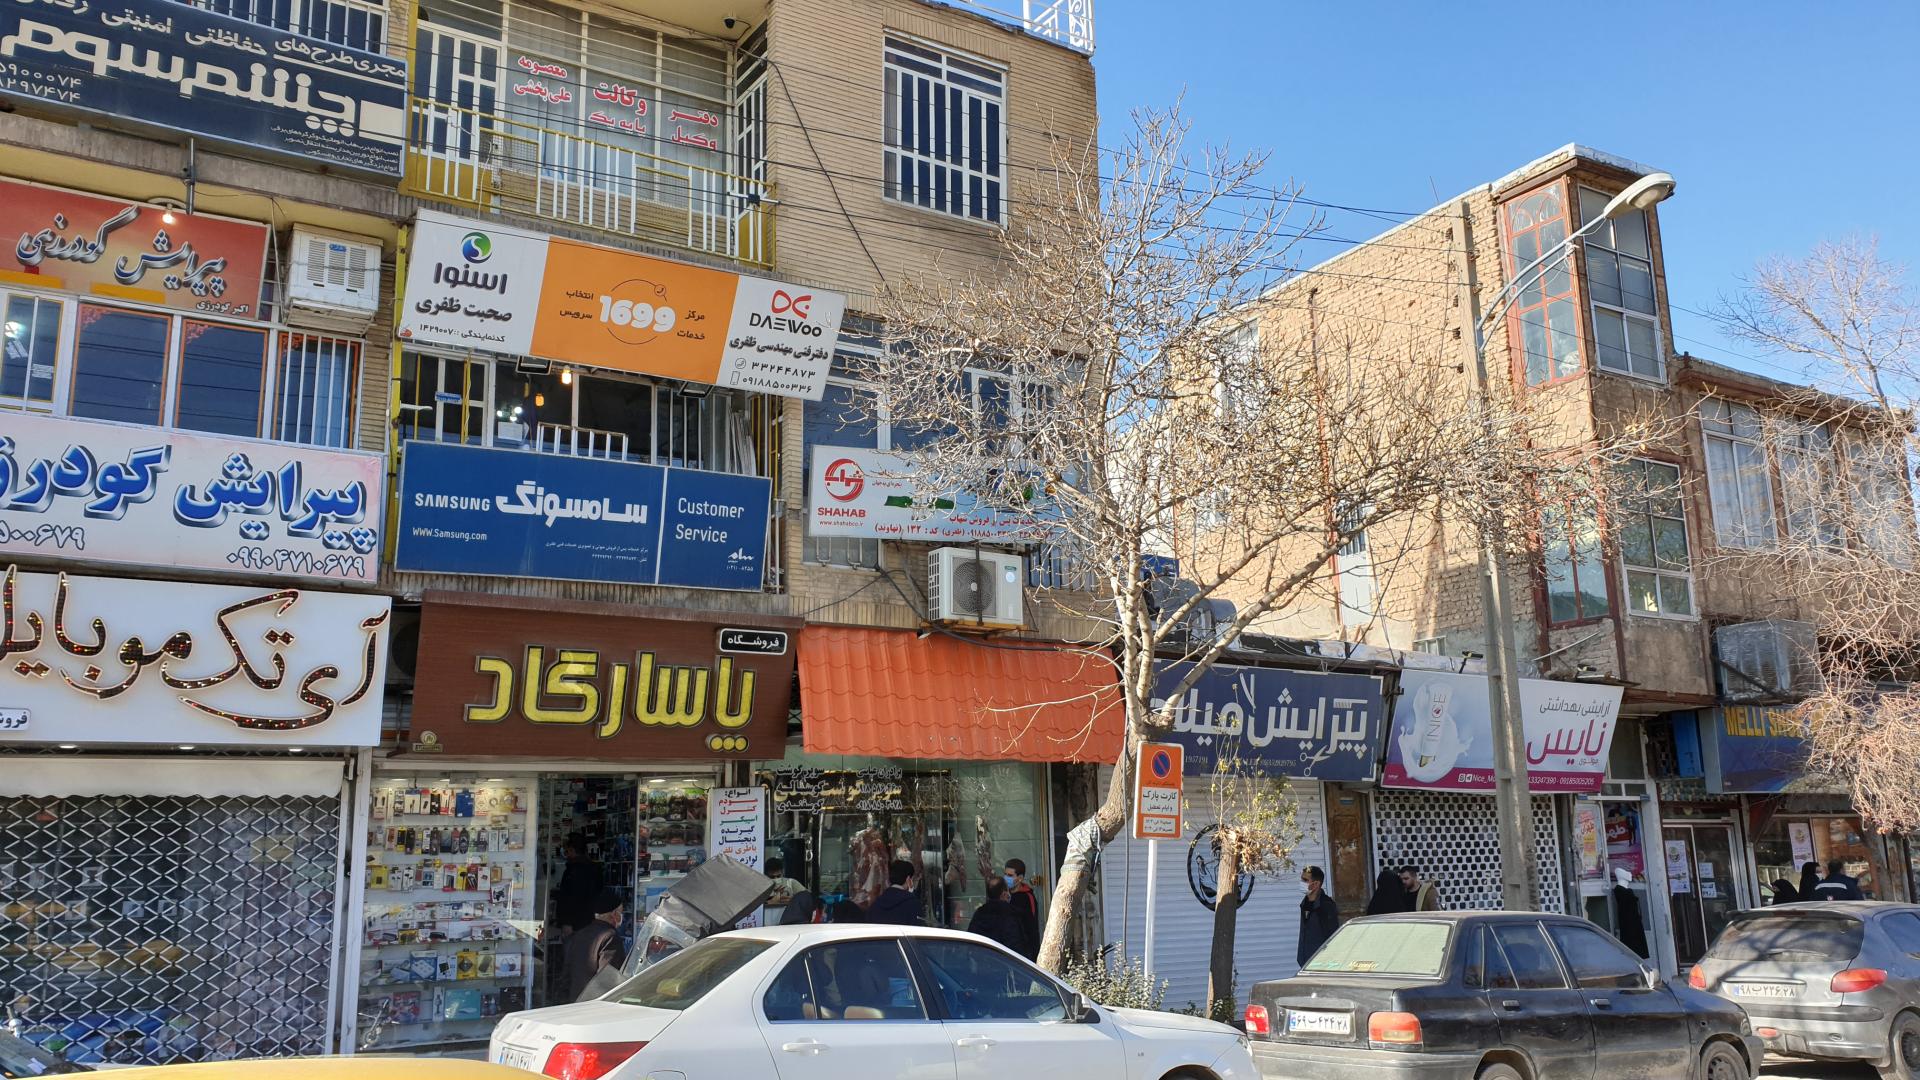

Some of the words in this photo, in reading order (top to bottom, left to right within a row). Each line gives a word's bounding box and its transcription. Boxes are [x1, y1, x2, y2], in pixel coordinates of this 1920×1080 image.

[101, 8, 171, 34] امنیتی
[1, 18, 184, 83] سوم
[185, 27, 267, 55] حفاظتی
[354, 60, 406, 78] مجری
[518, 55, 567, 79] معصومه
[179, 61, 355, 137] چشم
[593, 82, 648, 116] وکالت
[589, 110, 616, 128] یک
[669, 106, 719, 127] دفتر
[671, 125, 718, 151] وکیل
[15, 203, 141, 266] گودرزی
[113, 228, 228, 297] پیرایش
[433, 262, 508, 295] اسنوا
[566, 289, 594, 301] انتخاب
[196, 300, 231, 313] گودرزی
[231, 303, 250, 315] اکبر
[415, 297, 462, 316] ظفری
[463, 304, 513, 323] صحبت
[559, 309, 593, 320] سرویس
[600, 295, 676, 333] 1699
[685, 310, 706, 321] مرکز
[676, 328, 706, 341] خدمات
[749, 312, 823, 338] DAEWOO
[729, 335, 757, 350] ظفری
[756, 343, 793, 356] مهندسی
[793, 345, 812, 359] فنی
[808, 347, 829, 361] دفتر
[751, 361, 816, 378] ۳۳۲۴۴۸۷۳
[742, 377, 812, 393] ۰۹۱۸۸۵۰۰۳۳۶
[173, 452, 377, 554] پیرایش
[415, 492, 491, 511] SAMSUNG
[495, 479, 648, 528] سامسونگ
[678, 497, 745, 519] Customer
[817, 507, 866, 518] SHAHAB
[949, 515, 968, 524] شهاب
[969, 516, 990, 527] فروش
[675, 523, 728, 543] Service
[874, 522, 902, 534] (نهاوند)
[907, 524, 921, 534] ۱۳۲
[226, 546, 366, 577] ۰۹۹۰۴۷۱۰۶۷۹
[727, 634, 780, 650] فروشگاه
[463, 643, 756, 752] پاسارگاد
[1540, 696, 1581, 716] بهداشتی
[1150, 688, 1244, 746] میلا
[1247, 673, 1368, 760] پیرایش
[1581, 699, 1612, 717] آرایشی
[1724, 705, 1766, 737] MELLI
[1526, 719, 1607, 765] نایس
[776, 764, 802, 779] گوشت
[719, 797, 758, 806] مودم
[1143, 790, 1160, 801] پارک
[1160, 791, 1178, 801] کارت
[721, 825, 755, 835] گیرنده
